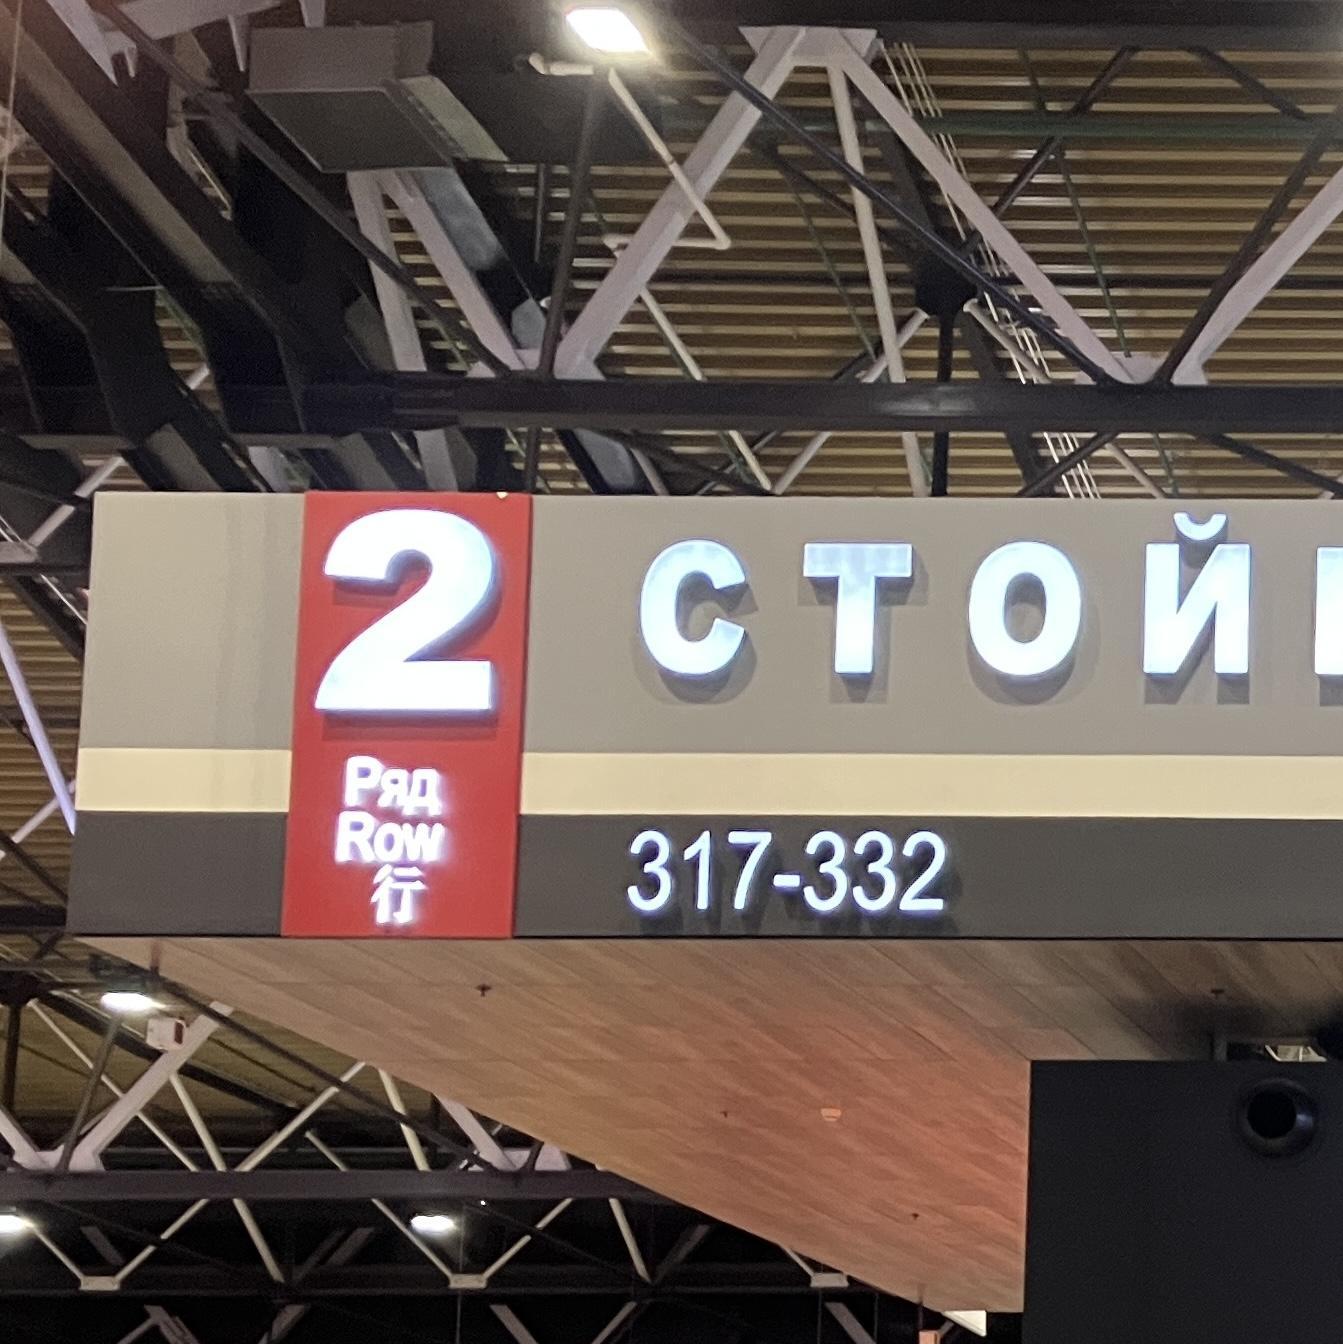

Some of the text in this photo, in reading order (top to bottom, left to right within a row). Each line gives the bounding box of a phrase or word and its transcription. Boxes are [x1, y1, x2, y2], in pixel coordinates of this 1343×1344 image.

[313, 508, 497, 712] 2
[344, 755, 442, 817] Ряд
[335, 811, 445, 863] Row
[370, 863, 428, 926] 行
[626, 829, 949, 914] 317-332
